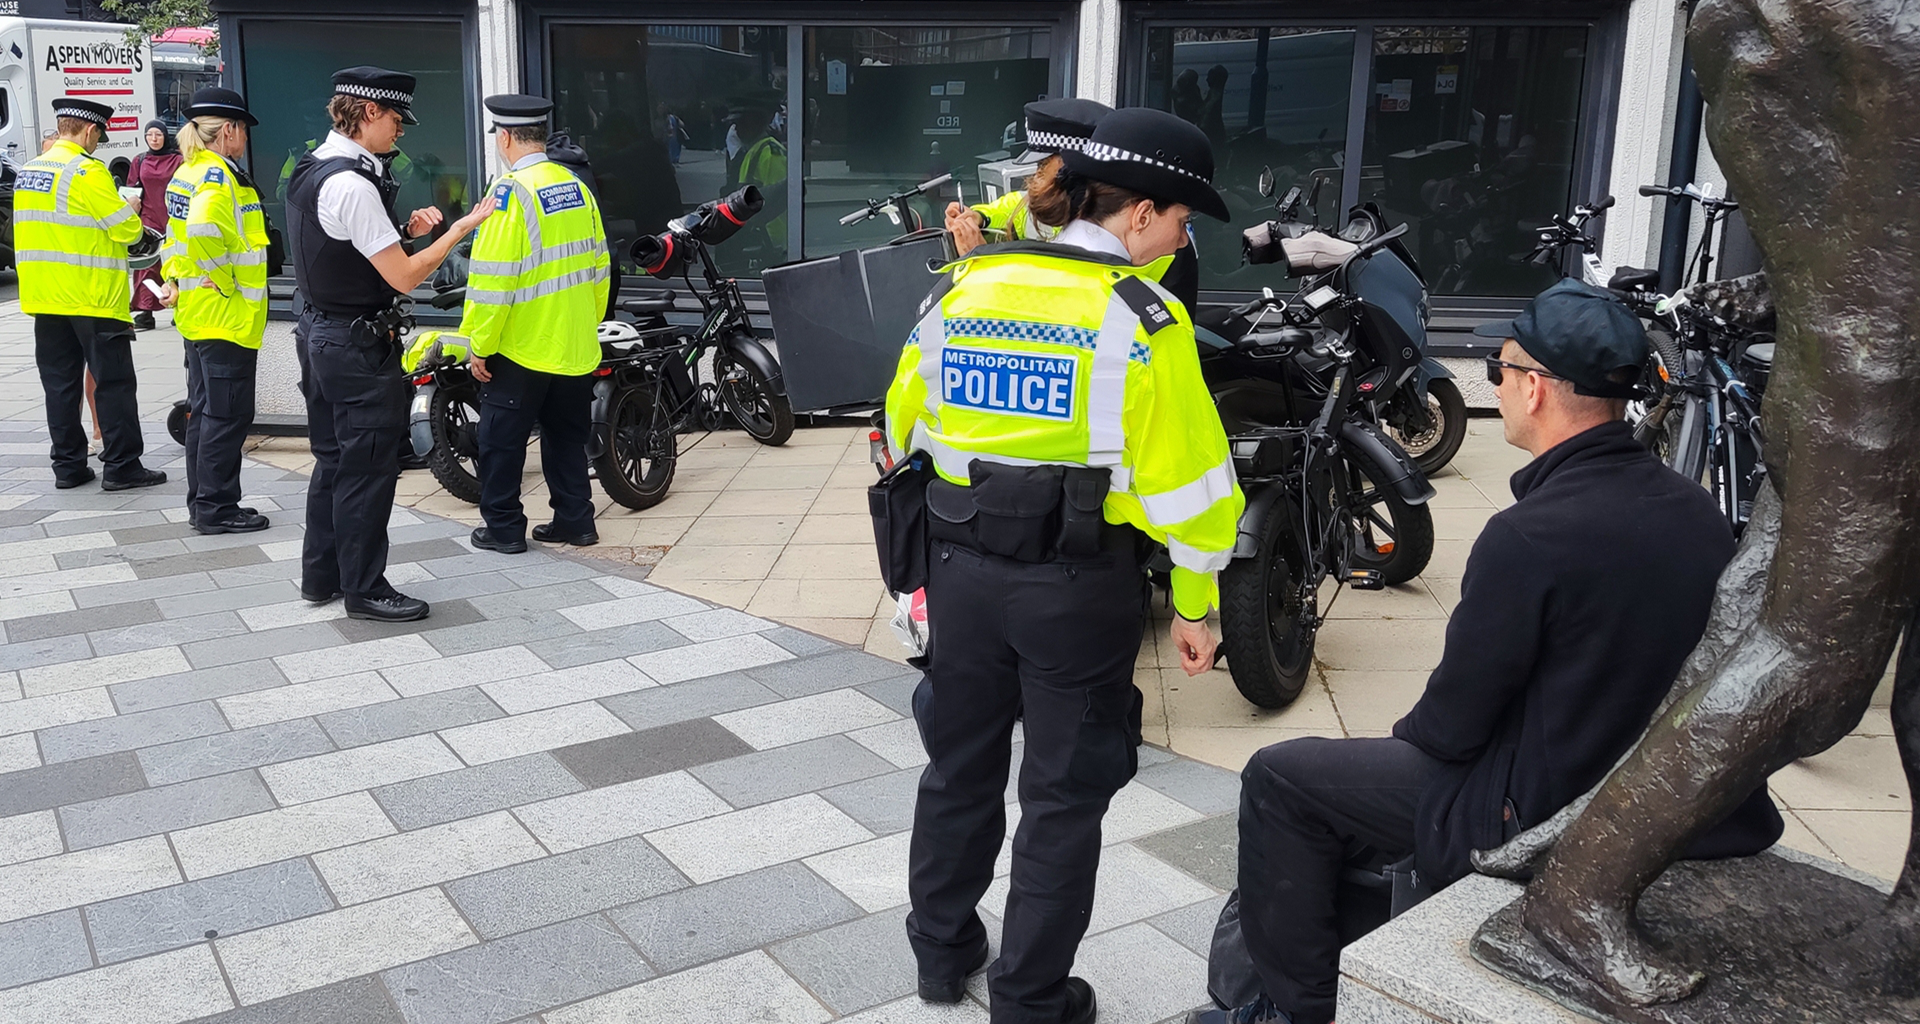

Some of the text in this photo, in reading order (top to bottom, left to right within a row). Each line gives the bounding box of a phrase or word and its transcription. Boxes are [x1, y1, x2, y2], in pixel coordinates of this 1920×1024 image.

[0, 1, 19, 9] USE
[46, 45, 143, 73] ASPEN MOVERS
[63, 77, 134, 87] Quality Service and Care
[118, 103, 142, 113] Shipping
[96, 141, 133, 150] enmovers.com
[15, 177, 52, 191] POLICE
[540, 184, 578, 199] COMMUNITY
[547, 193, 578, 206] SUPPORT
[1145, 302, 1161, 315] SW
[709, 308, 729, 337] ALLEGRO
[944, 351, 1071, 375] METROPOLITAN
[944, 366, 1069, 414] POLICE
